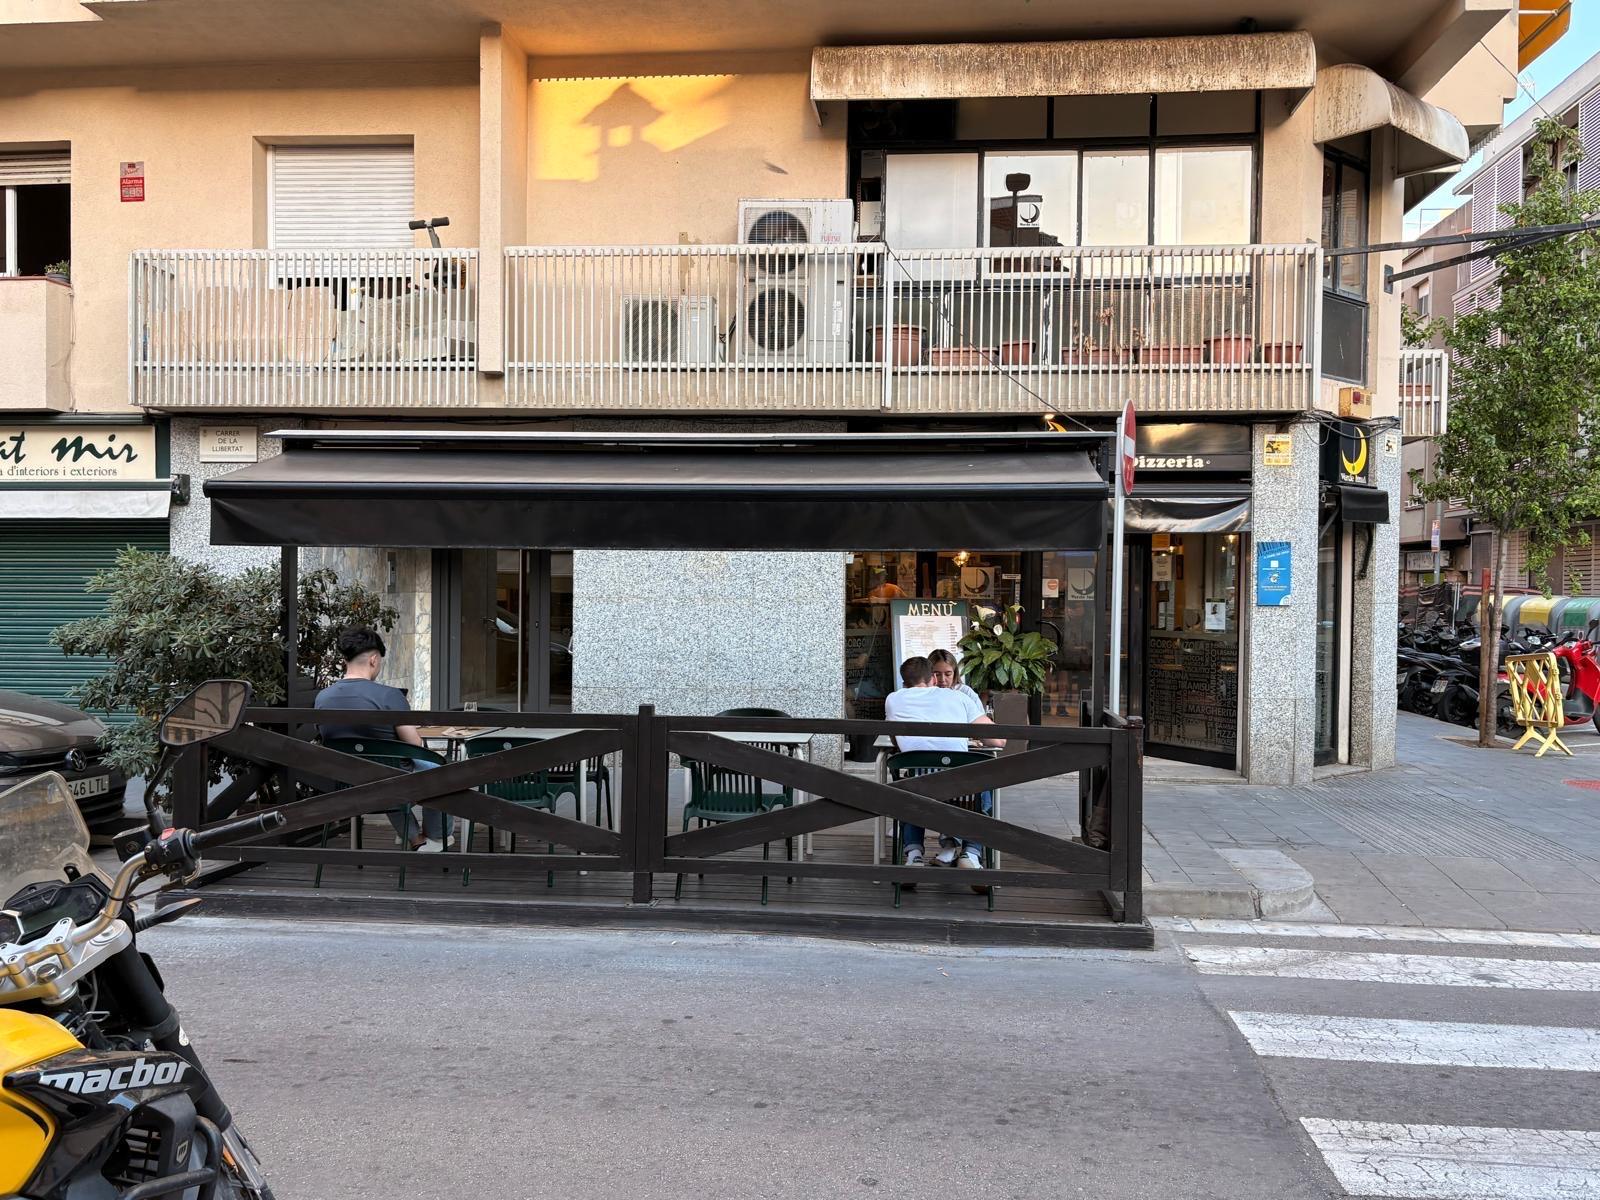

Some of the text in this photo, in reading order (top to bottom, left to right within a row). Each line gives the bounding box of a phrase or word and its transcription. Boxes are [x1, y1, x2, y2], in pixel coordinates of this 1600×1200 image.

[51, 434, 138, 463] mir
[7, 465, 59, 476] d'interiors
[70, 466, 117, 476] exteriors
[1188, 704, 1237, 717] MARGHERITA
[89, 778, 106, 794] LTL
[39, 1058, 191, 1094] macbor
